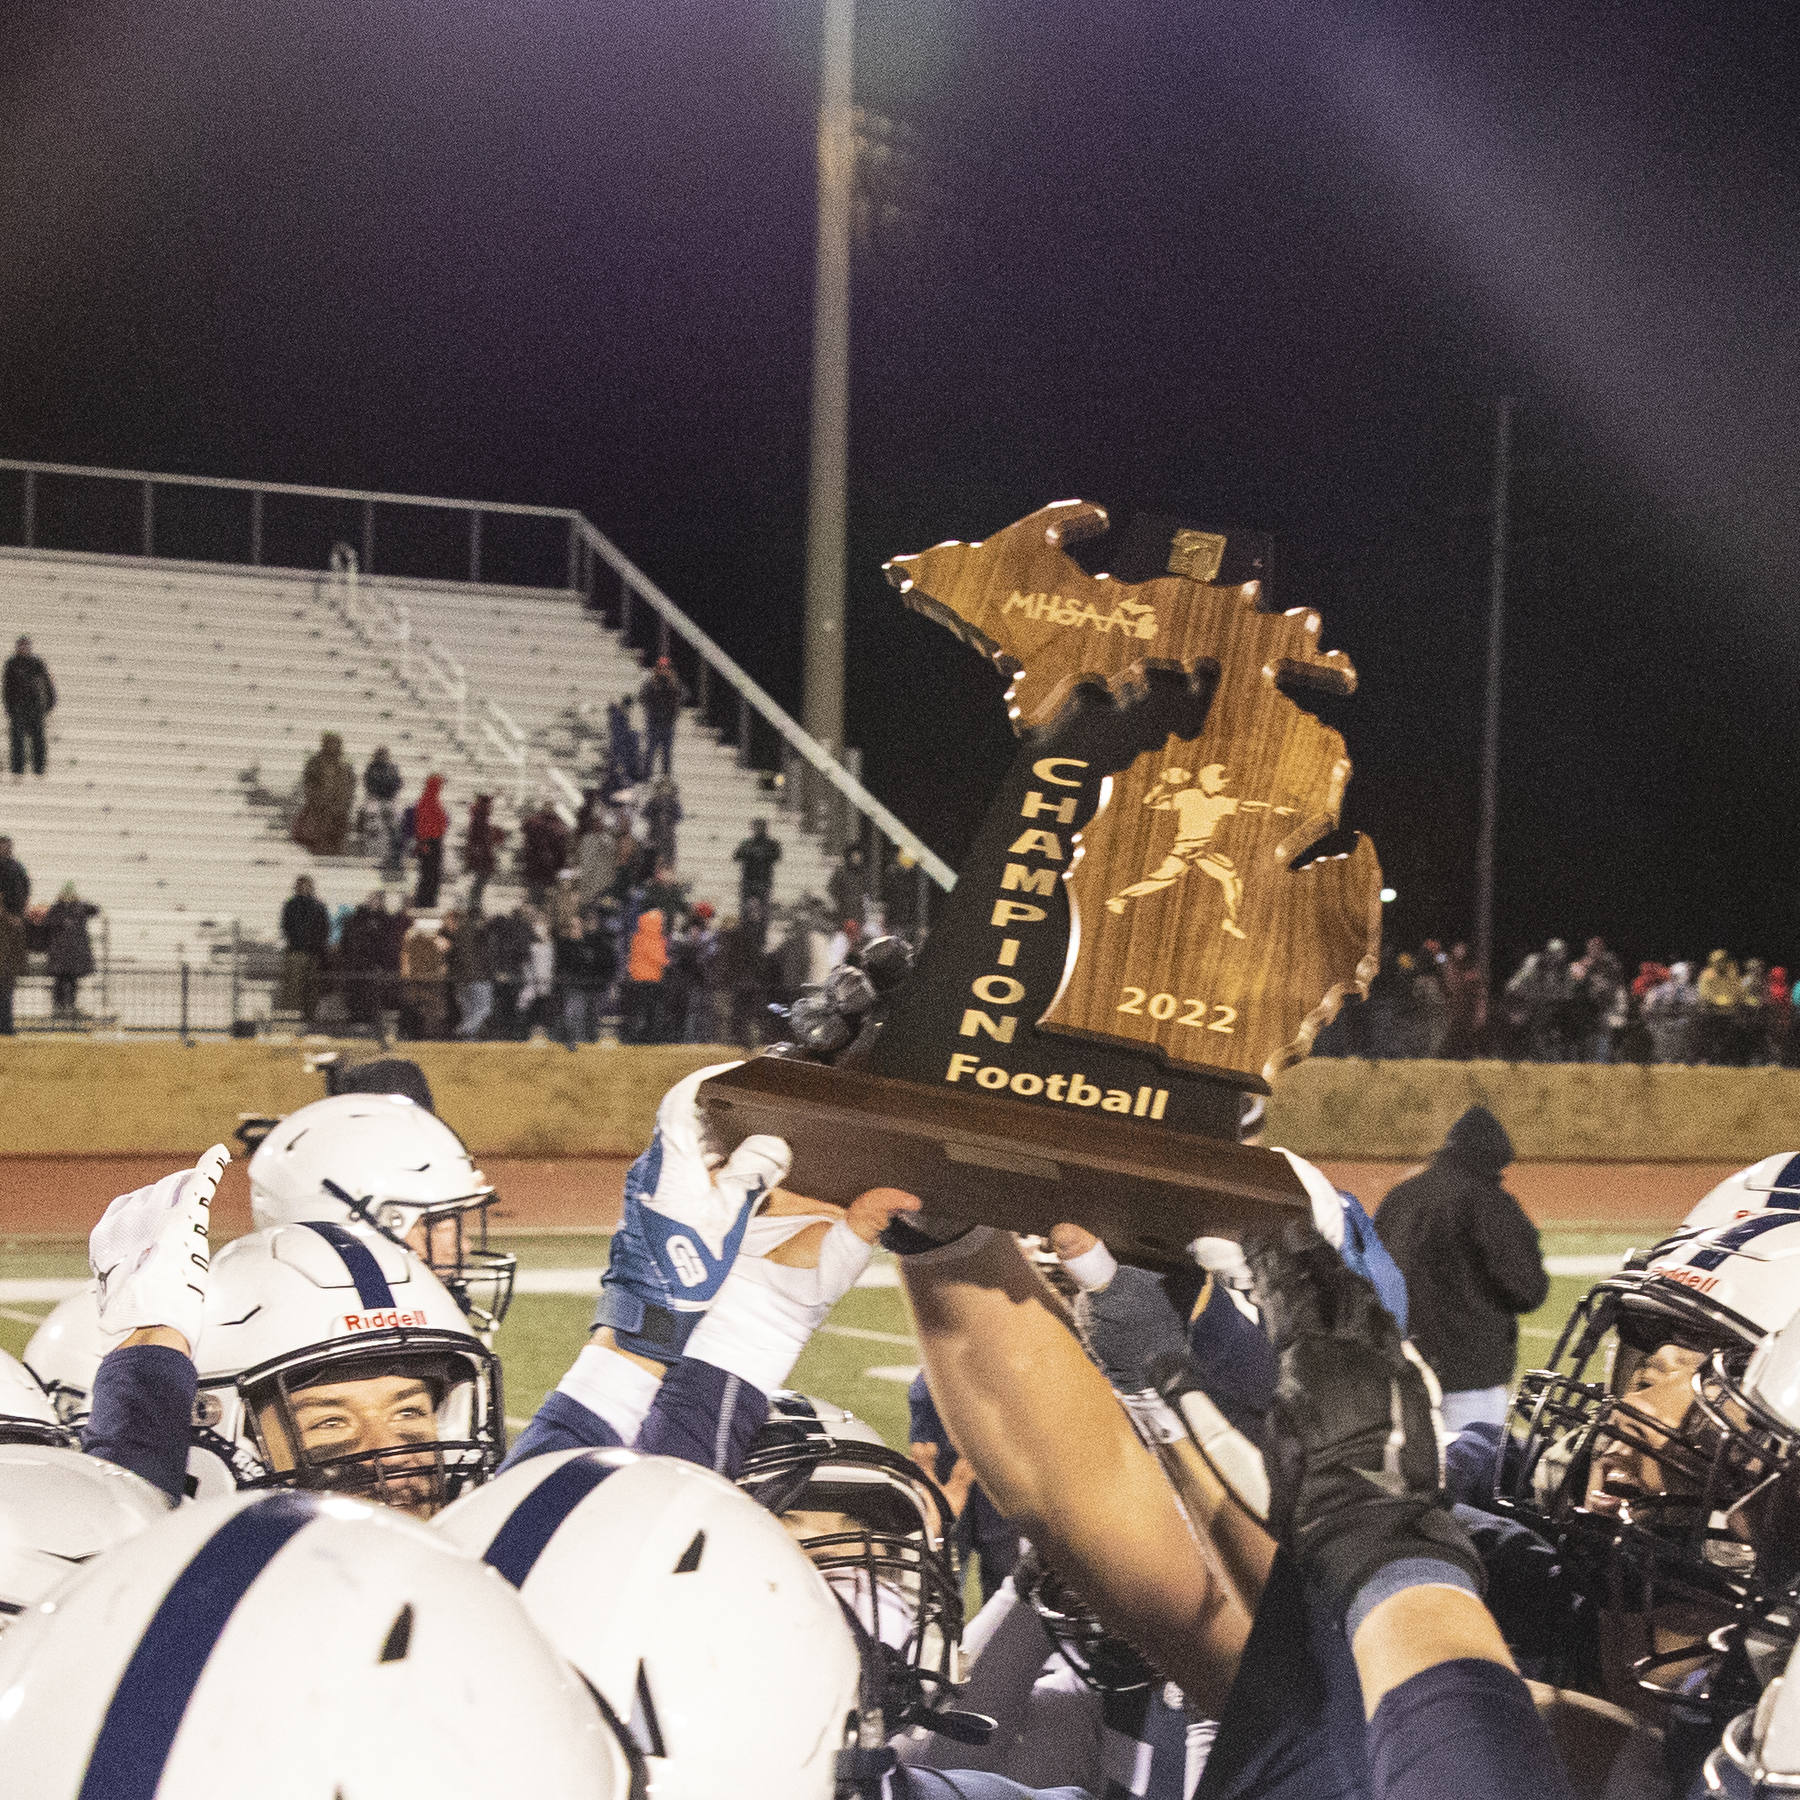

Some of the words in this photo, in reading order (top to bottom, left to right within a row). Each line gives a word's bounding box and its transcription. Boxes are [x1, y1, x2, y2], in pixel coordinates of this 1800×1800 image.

[959, 757, 1089, 1044] CHAMPION
[1117, 986, 1237, 1034] 2022
[945, 1053, 1169, 1121] Football
[343, 1310, 428, 1331] Riddell
